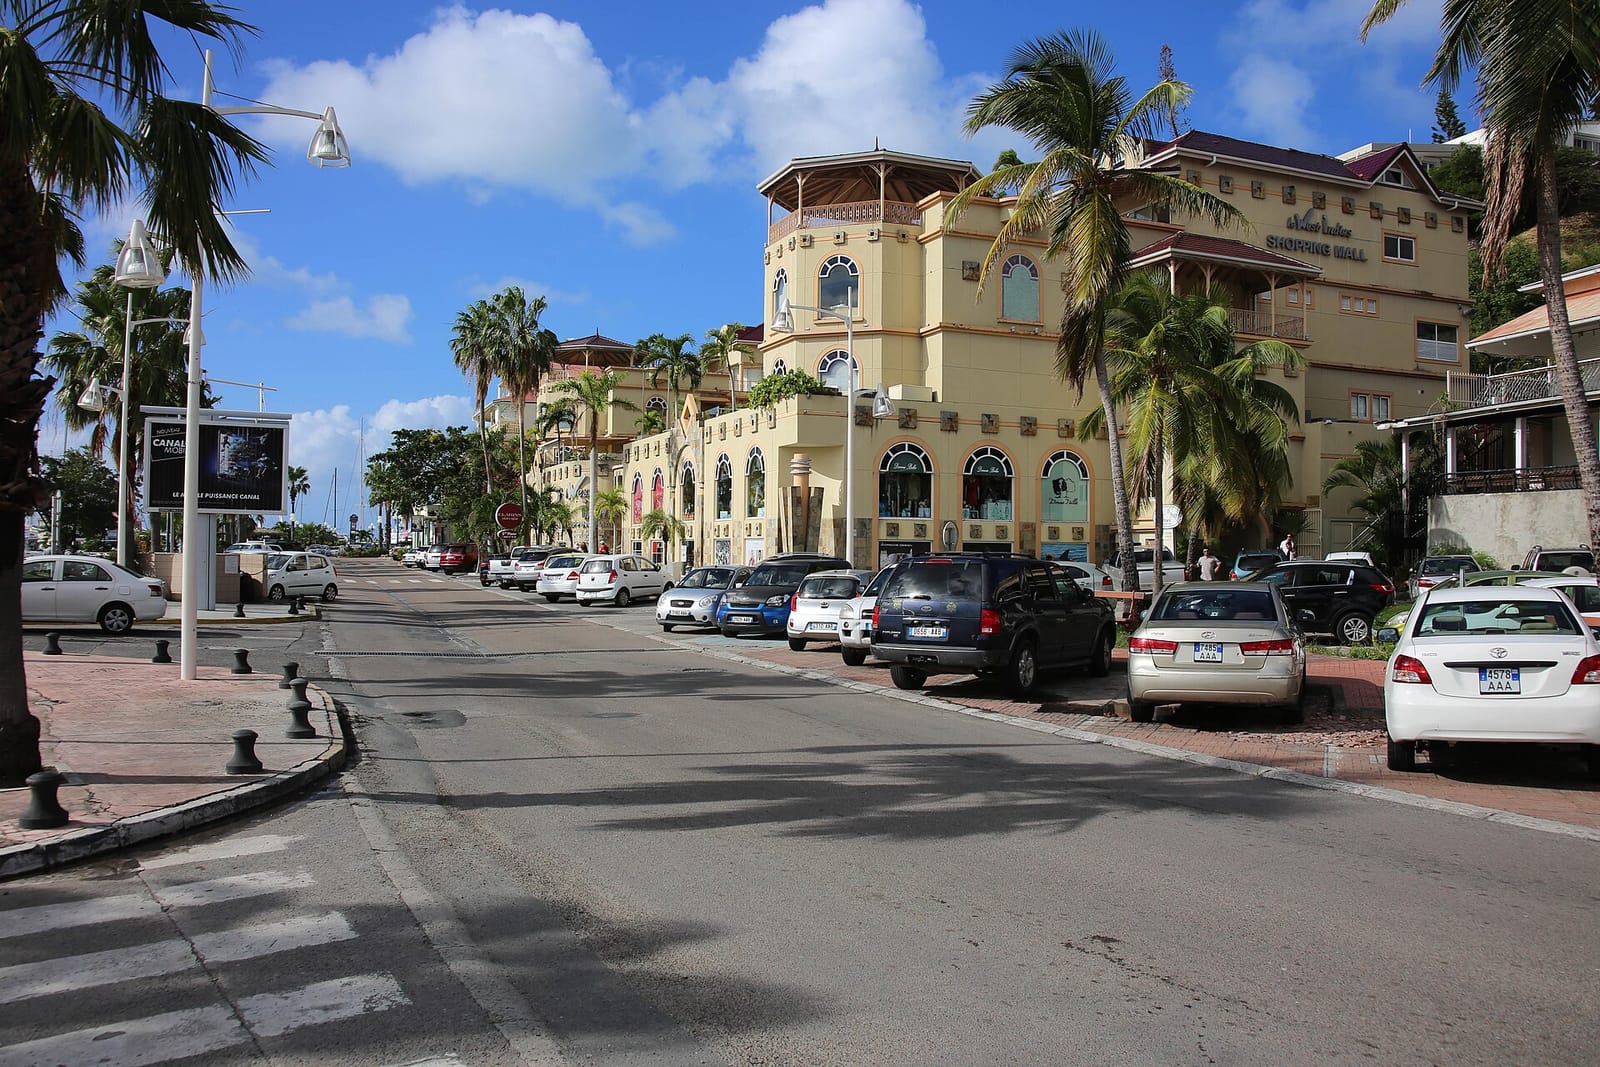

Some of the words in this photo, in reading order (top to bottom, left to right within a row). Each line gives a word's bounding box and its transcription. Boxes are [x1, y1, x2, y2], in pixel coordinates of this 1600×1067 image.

[1294, 207, 1321, 232] West
[1321, 213, 1352, 239] Indies
[1266, 234, 1331, 256] SHOPPING
[1333, 245, 1369, 262] MALL
[153, 438, 186, 447] CANAL
[1200, 643, 1217, 652] 7485
[1487, 669, 1511, 680] 4578
[1488, 681, 1512, 691] AAA
